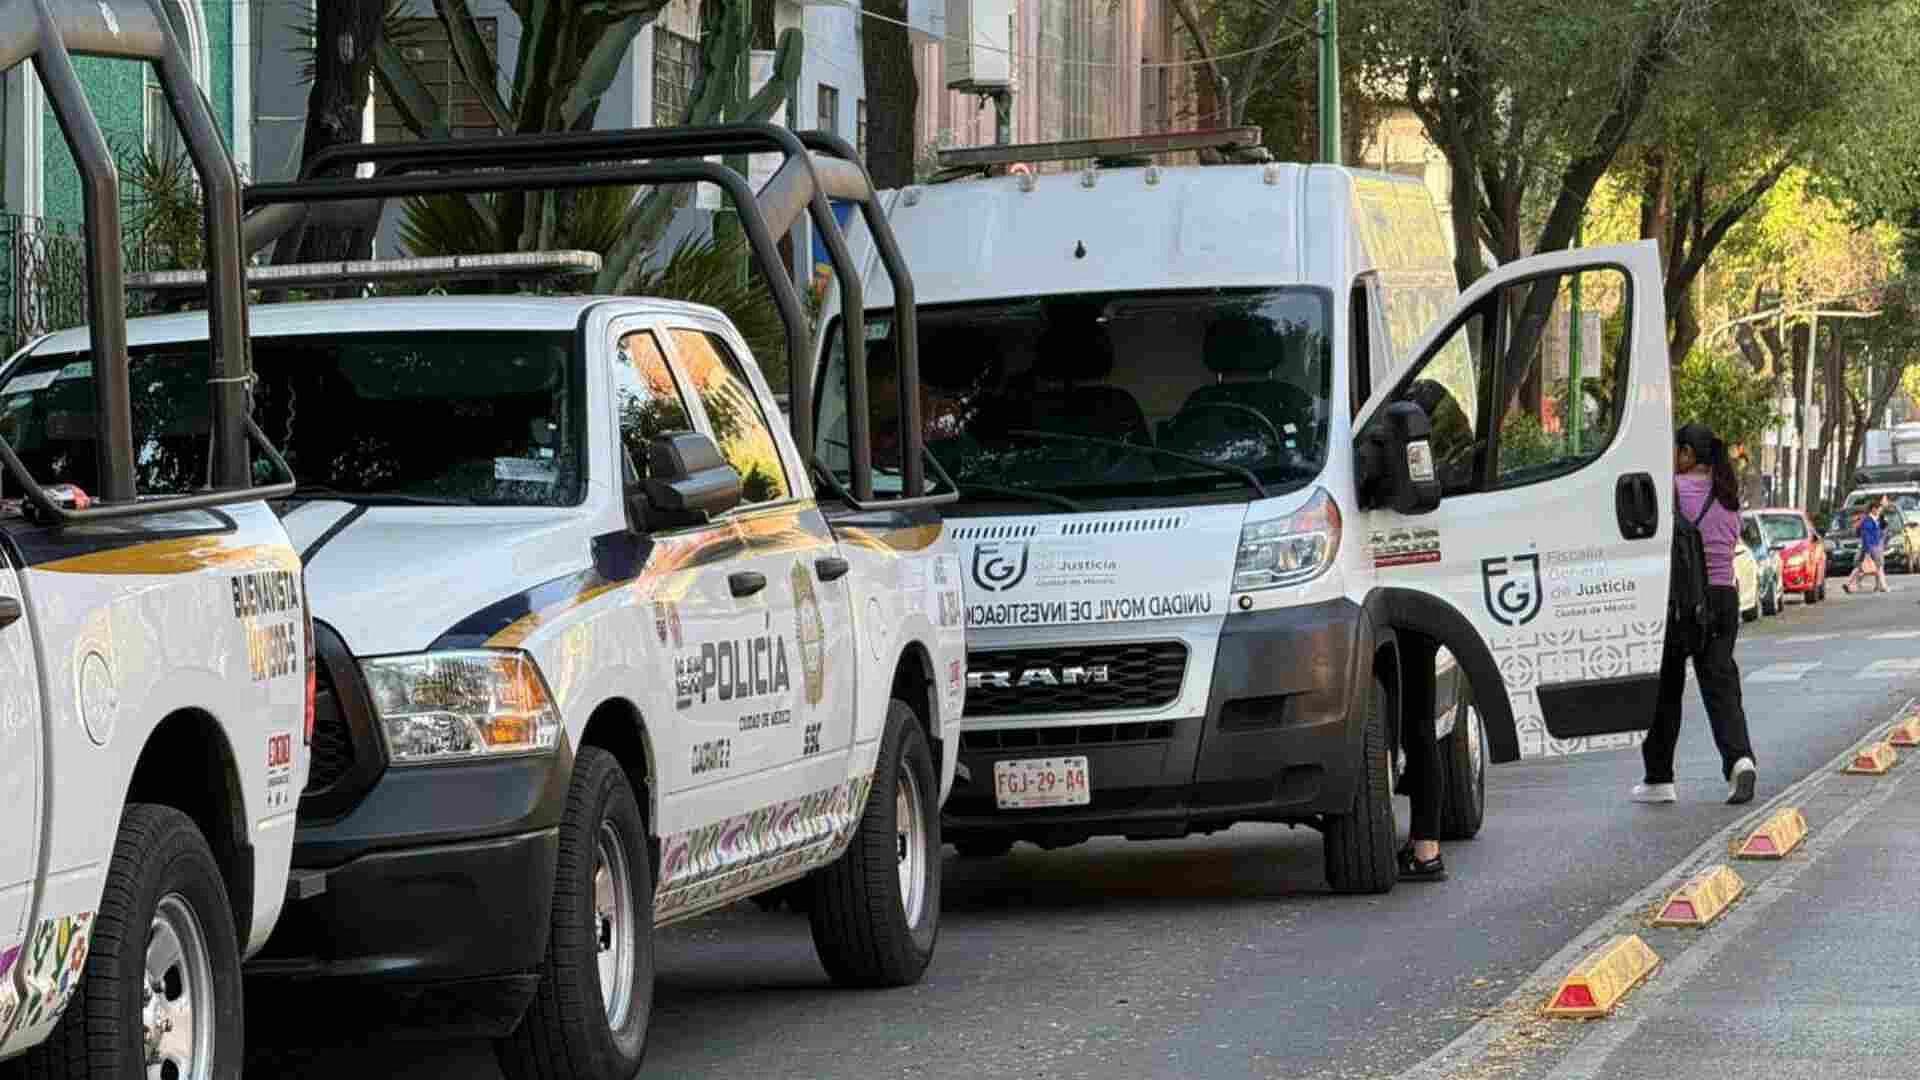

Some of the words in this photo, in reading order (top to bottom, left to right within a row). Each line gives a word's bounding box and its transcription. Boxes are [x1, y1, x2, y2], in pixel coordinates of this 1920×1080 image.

[1059, 558, 1118, 571] Justicia
[231, 571, 299, 617] BUENAVISTA
[1576, 579, 1635, 596] Justicia
[702, 611, 790, 704] POLICÍA
[967, 664, 1109, 689] RAM
